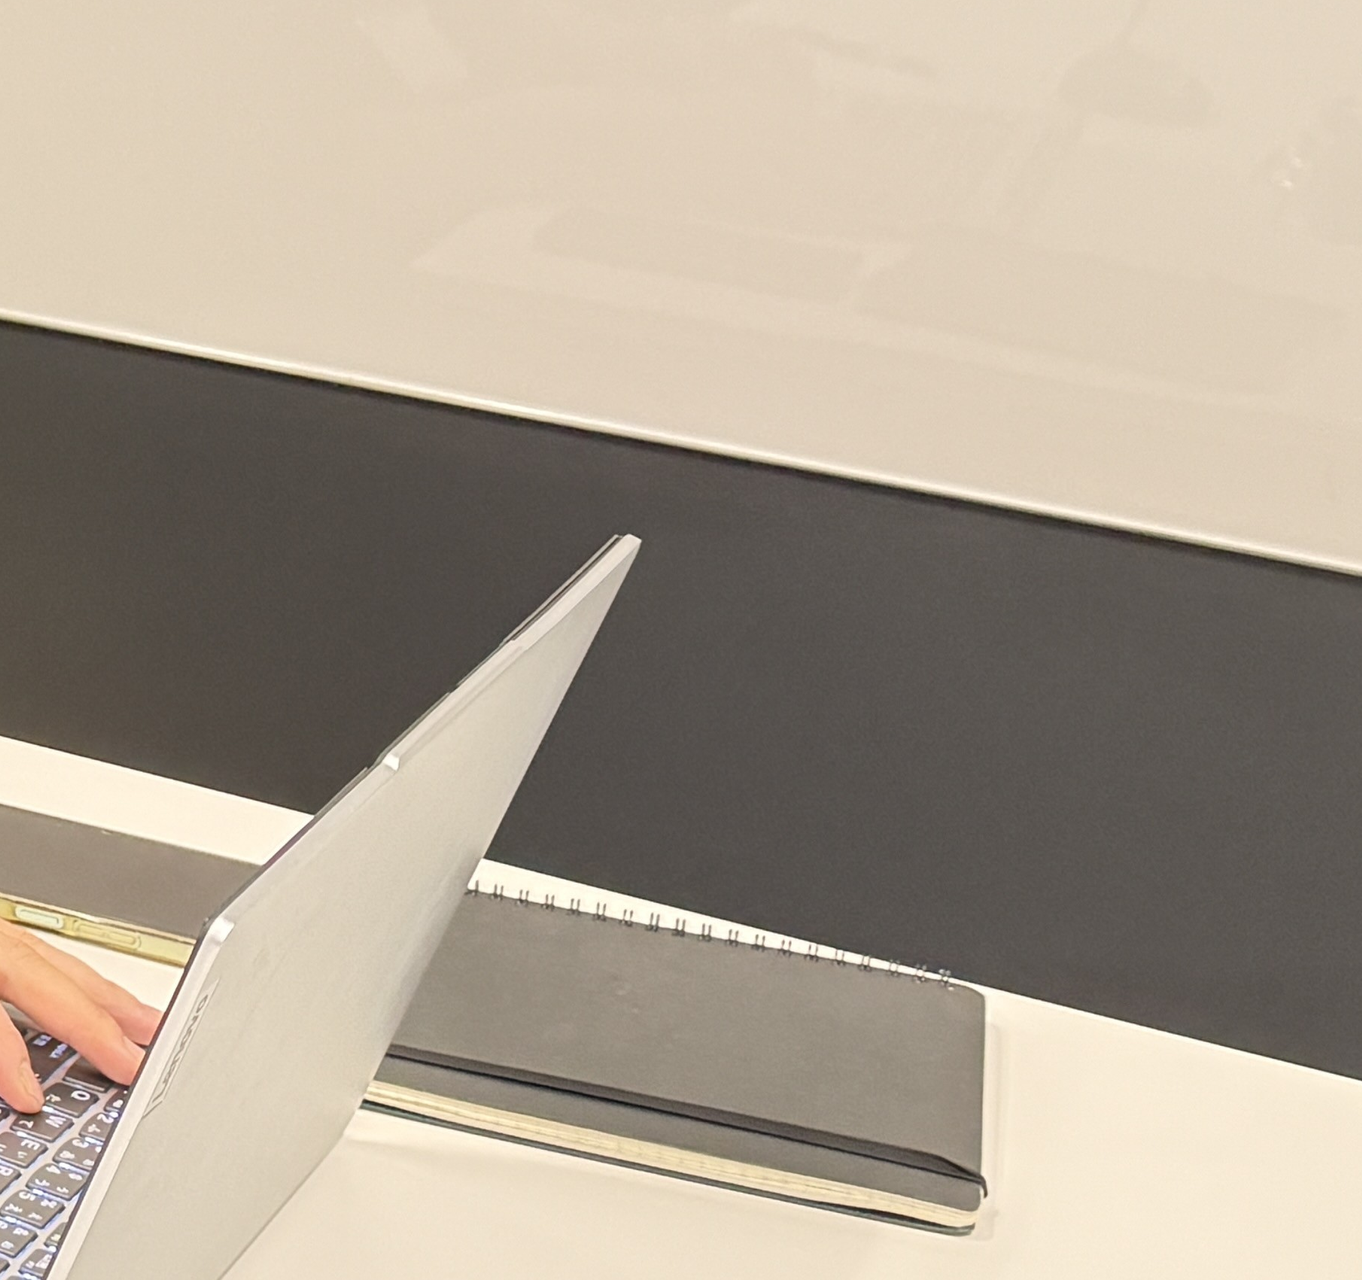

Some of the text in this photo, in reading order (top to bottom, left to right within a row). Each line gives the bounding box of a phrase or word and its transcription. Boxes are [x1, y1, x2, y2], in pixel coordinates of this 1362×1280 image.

[152, 994, 208, 1102] Lenovo
[71, 1090, 90, 1101] Q
[45, 1115, 67, 1128] W
[97, 1113, 114, 1124] 2
[21, 1139, 40, 1150] E
[72, 1139, 89, 1148] 3
[46, 1165, 61, 1174] 4
[19, 1191, 35, 1201] 5
